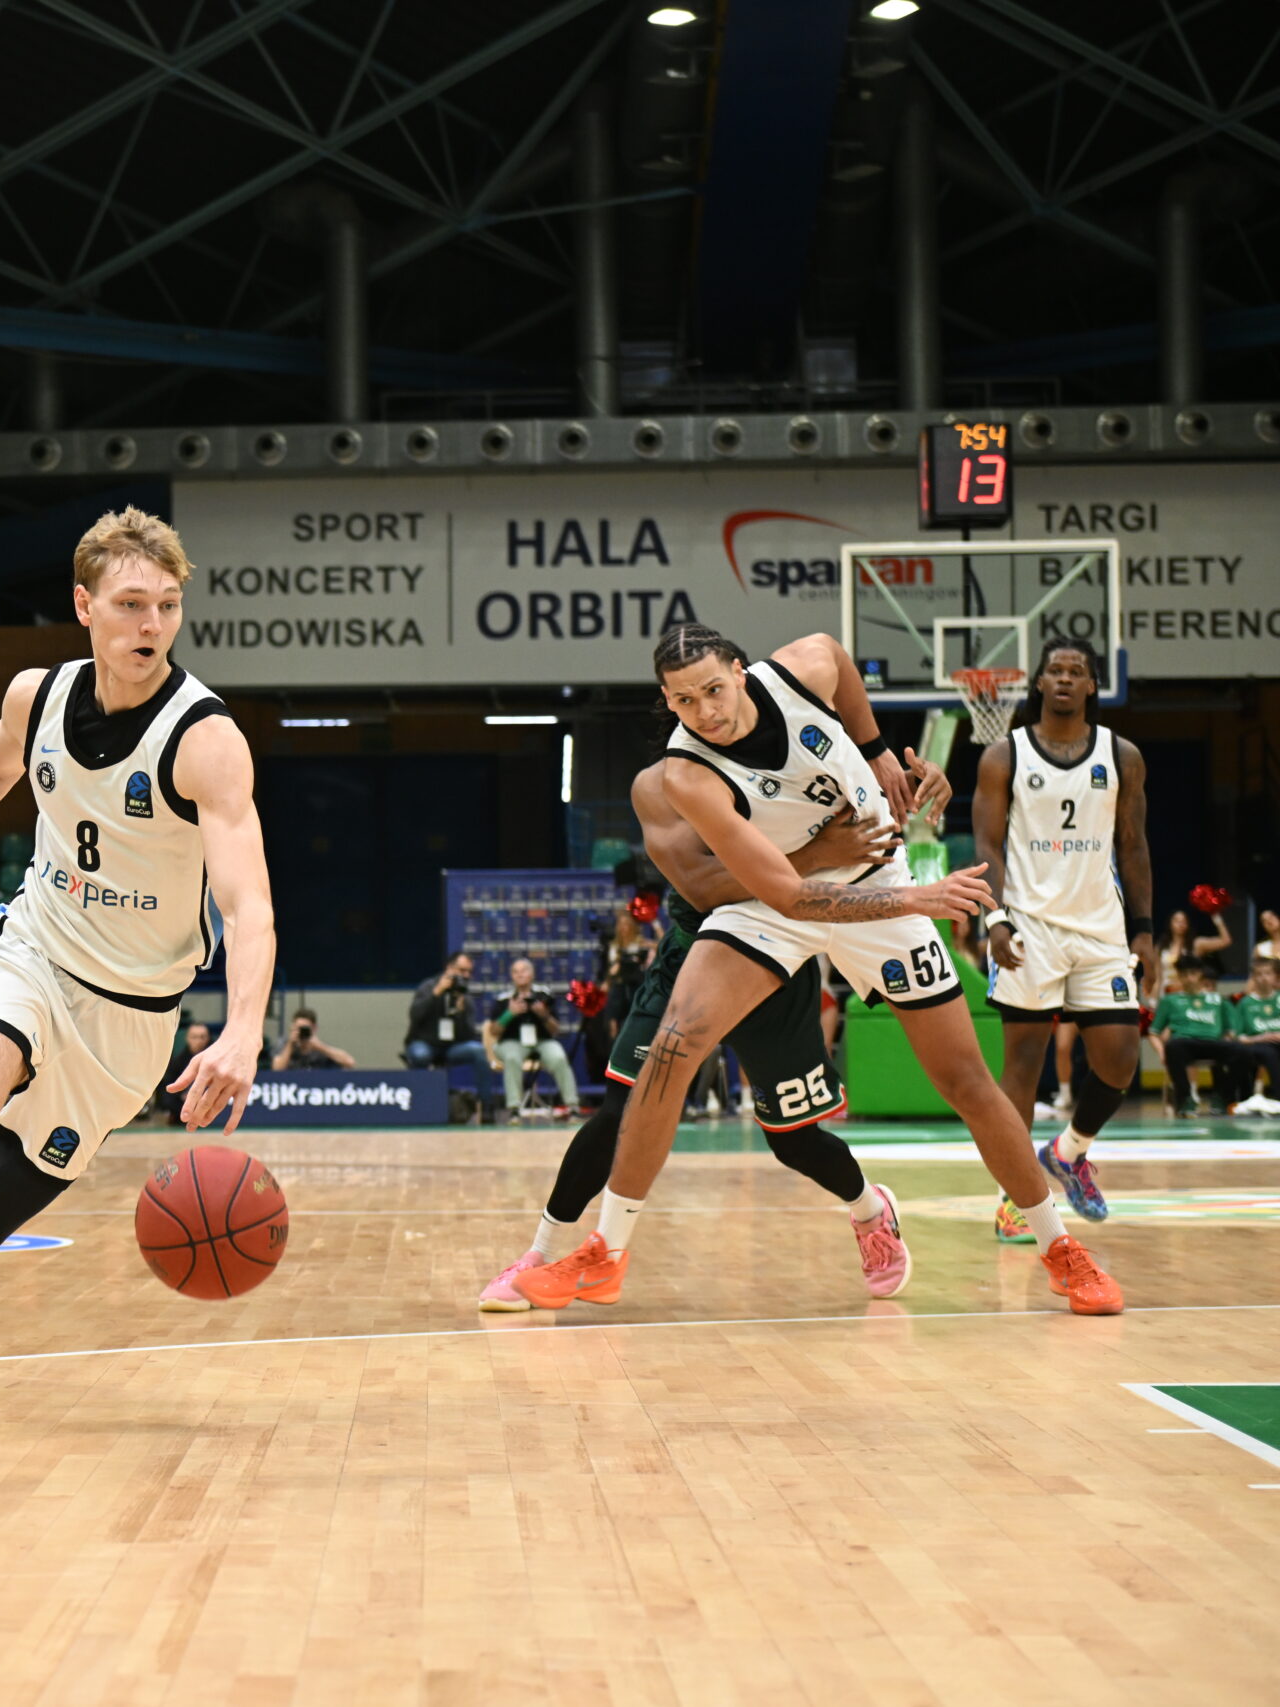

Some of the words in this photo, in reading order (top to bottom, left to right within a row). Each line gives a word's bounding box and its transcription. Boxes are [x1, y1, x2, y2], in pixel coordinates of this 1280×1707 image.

[958, 454, 1006, 504] 13
[292, 513, 425, 543] SPORT
[1038, 504, 1158, 533] TARGI
[506, 518, 670, 568] HALA
[208, 566, 425, 596] KONCERTY
[1039, 556, 1243, 586] BAKIETY
[476, 590, 701, 641] ORBITA
[189, 619, 425, 649] WIDOWISKA
[126, 806, 151, 816] EuroCup
[1061, 799, 1076, 830] 2
[76, 820, 101, 872] 8
[1030, 836, 1102, 856] nexperia
[909, 940, 951, 987] 52
[228, 1082, 412, 1111] PijKranówkę
[776, 1063, 833, 1117] 25
[41, 1151, 66, 1166] EuroCup
